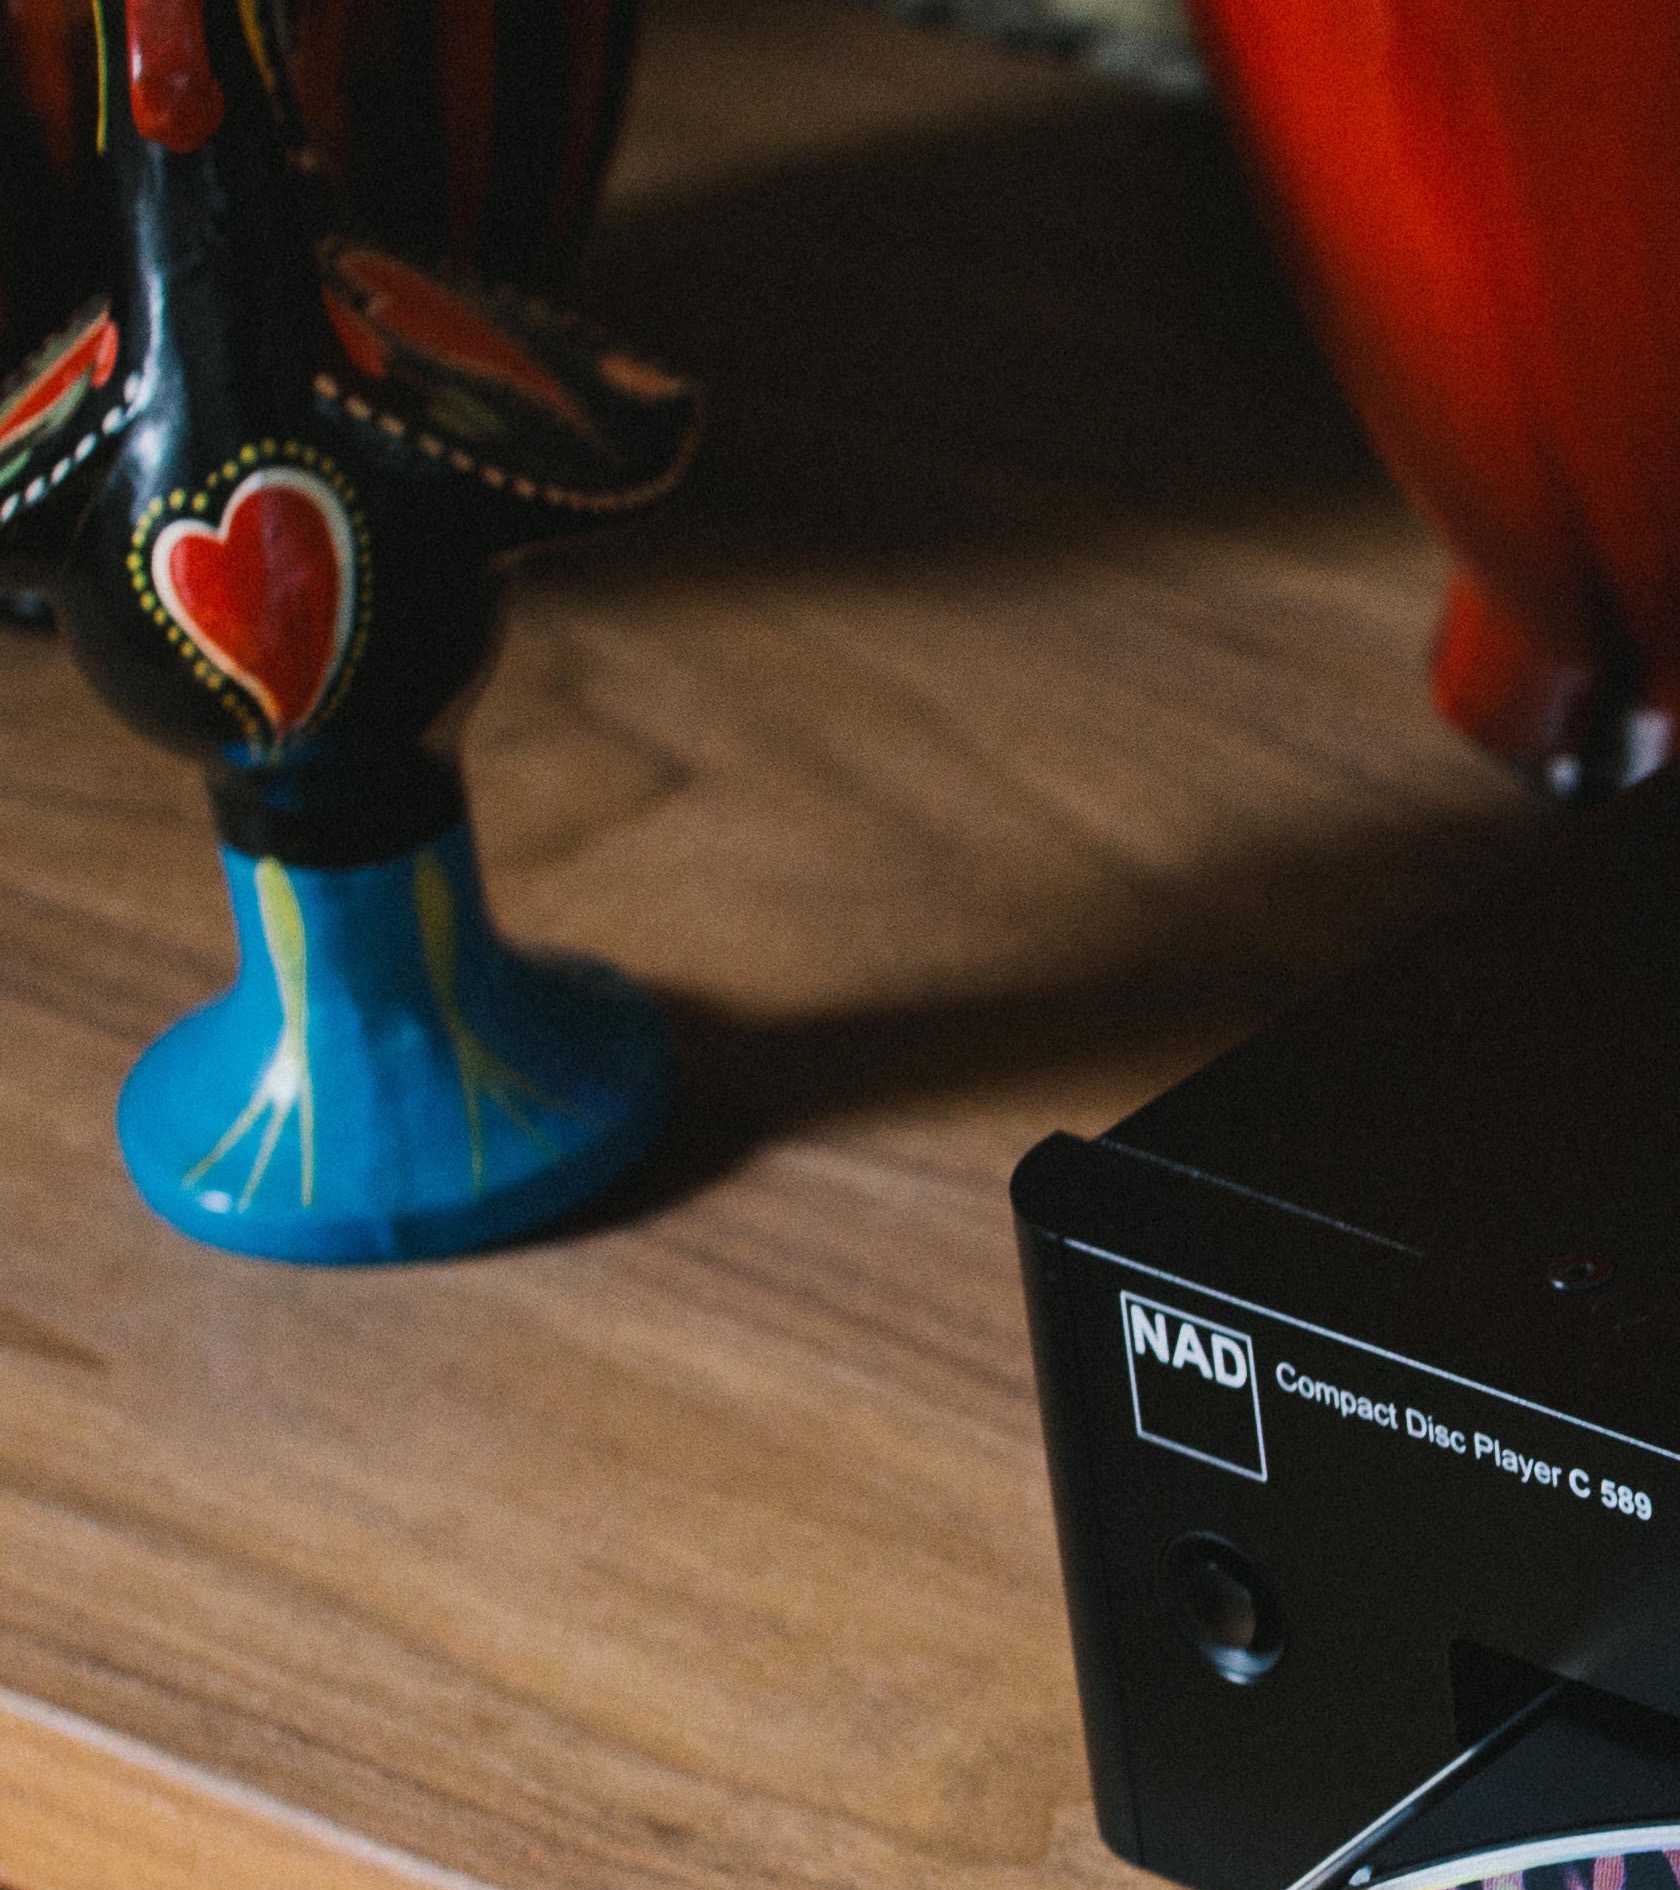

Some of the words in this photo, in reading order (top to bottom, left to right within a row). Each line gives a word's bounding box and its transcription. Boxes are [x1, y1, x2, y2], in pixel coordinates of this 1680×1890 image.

[1130, 1304, 1248, 1390] NAD
[1275, 1361, 1399, 1430] Compact
[1406, 1407, 1467, 1455] Disc
[1474, 1431, 1563, 1488] Player
[1568, 1467, 1592, 1498] C
[1599, 1479, 1653, 1521] 589
